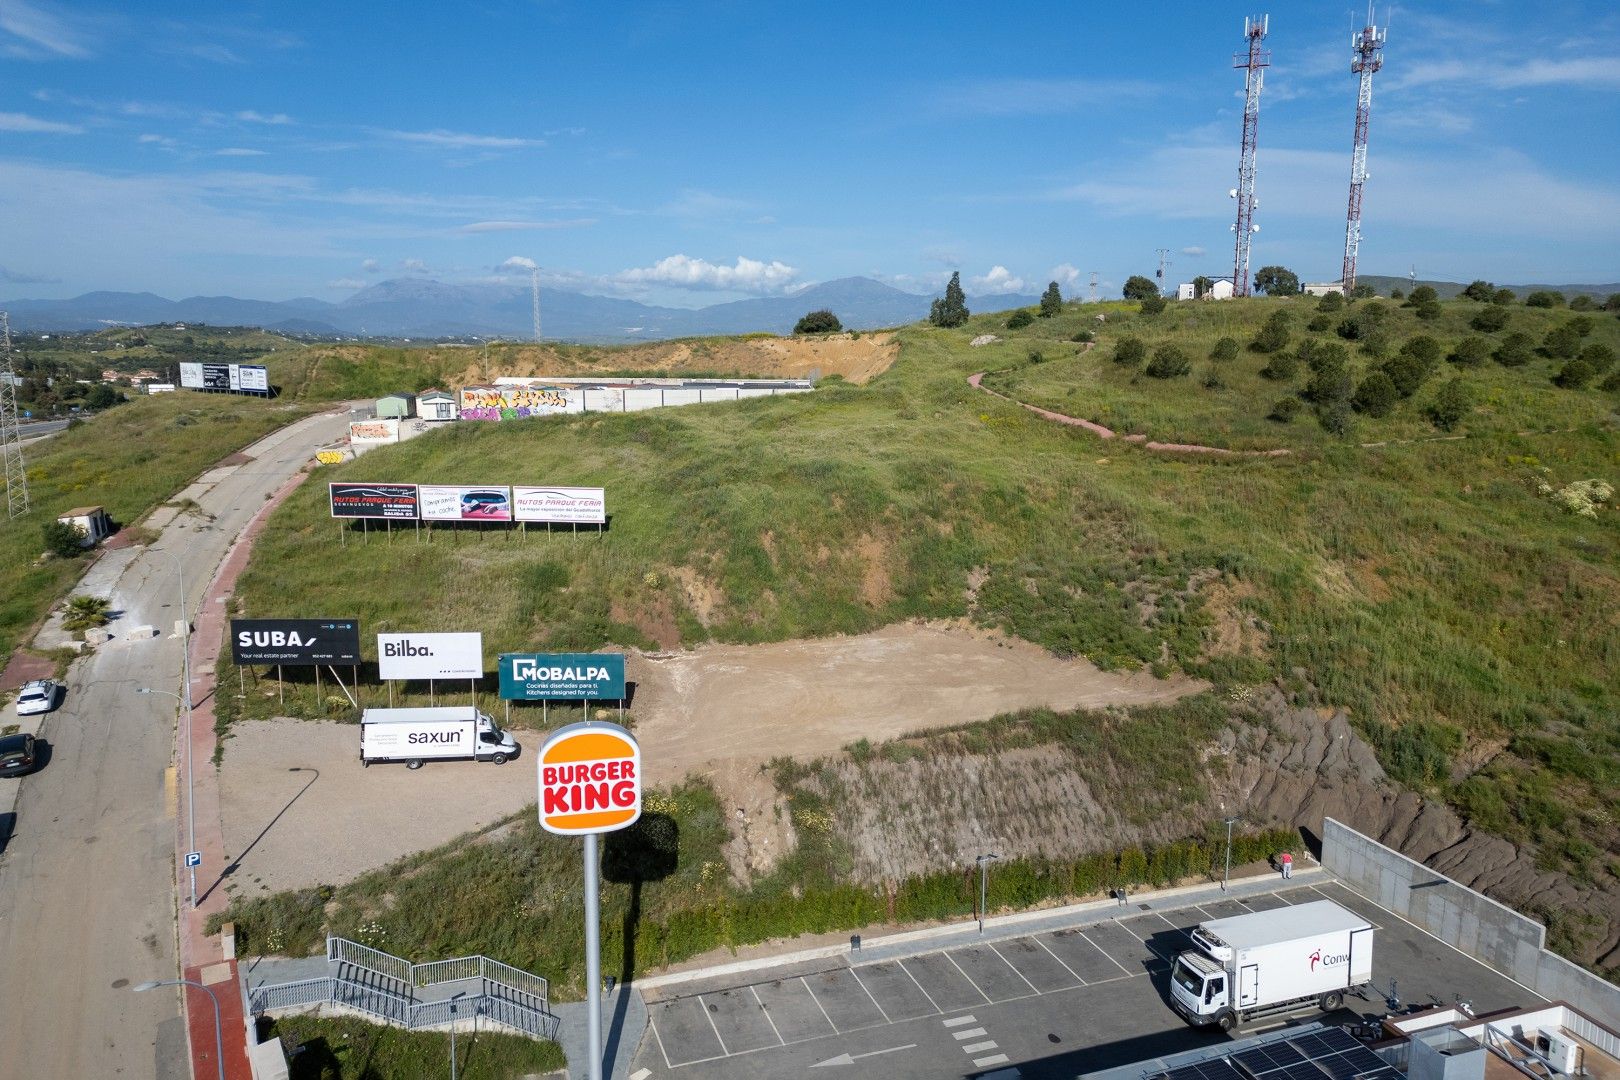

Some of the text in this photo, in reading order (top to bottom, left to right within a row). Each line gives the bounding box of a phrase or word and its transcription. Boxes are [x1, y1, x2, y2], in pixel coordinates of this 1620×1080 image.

[239, 631, 302, 647] SUBA
[385, 640, 434, 656] Bilba.
[521, 667, 610, 680] MOBALPA
[408, 731, 460, 744] saxun
[543, 761, 635, 786] BURGER
[544, 781, 636, 814] KING
[188, 854, 199, 866] P
